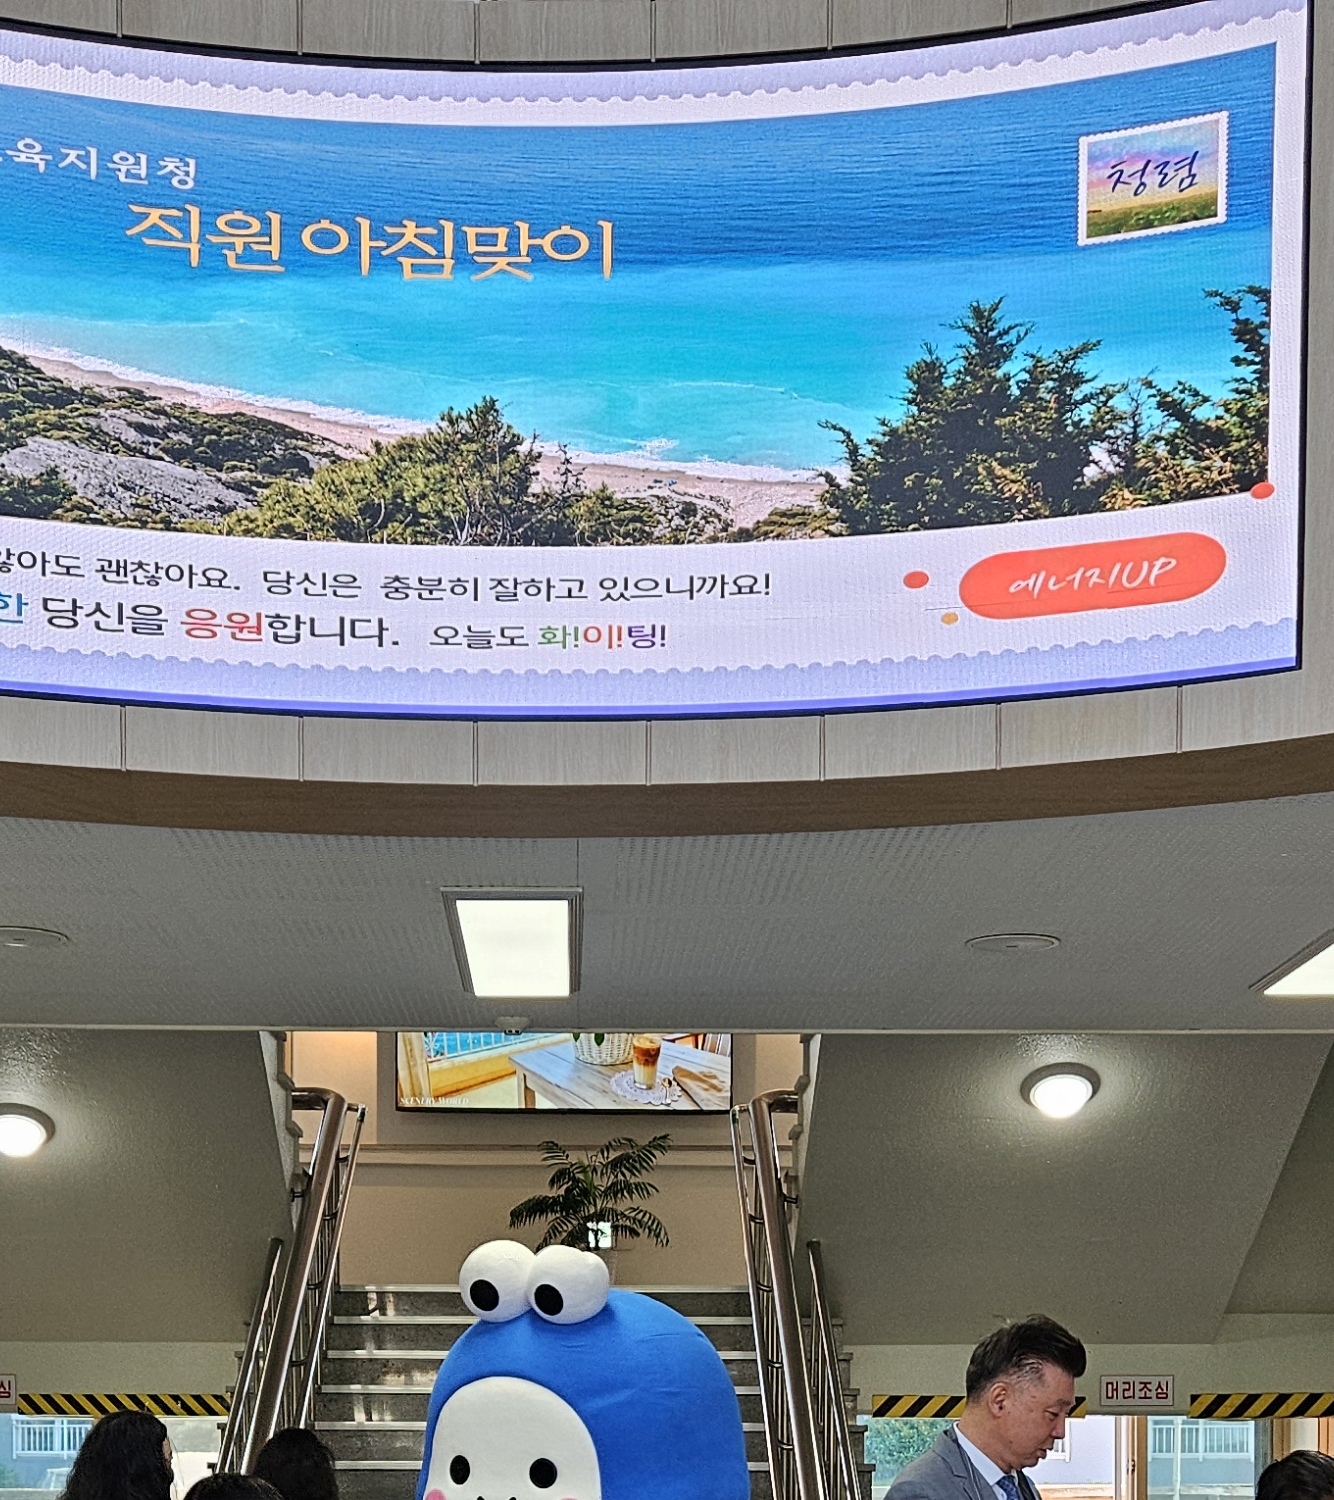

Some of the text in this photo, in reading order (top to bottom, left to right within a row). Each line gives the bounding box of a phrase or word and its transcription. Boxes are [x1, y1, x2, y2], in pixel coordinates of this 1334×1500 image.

[1106, 150, 1200, 196] 청렴
[125, 202, 614, 281] 직원 아침맞이
[96, 555, 241, 591] 괜찮아요.
[263, 570, 362, 600] 당신은
[380, 573, 480, 601] 충분히
[489, 575, 588, 602] 잘하고
[599, 572, 771, 603] 있으니까요!
[41, 596, 169, 636] 당신을
[180, 607, 400, 648] 응원합니다.
[429, 625, 530, 650] 오늘도
[538, 622, 667, 650] 화!이!팅!
[1105, 1381, 1168, 1400] 머리조심
